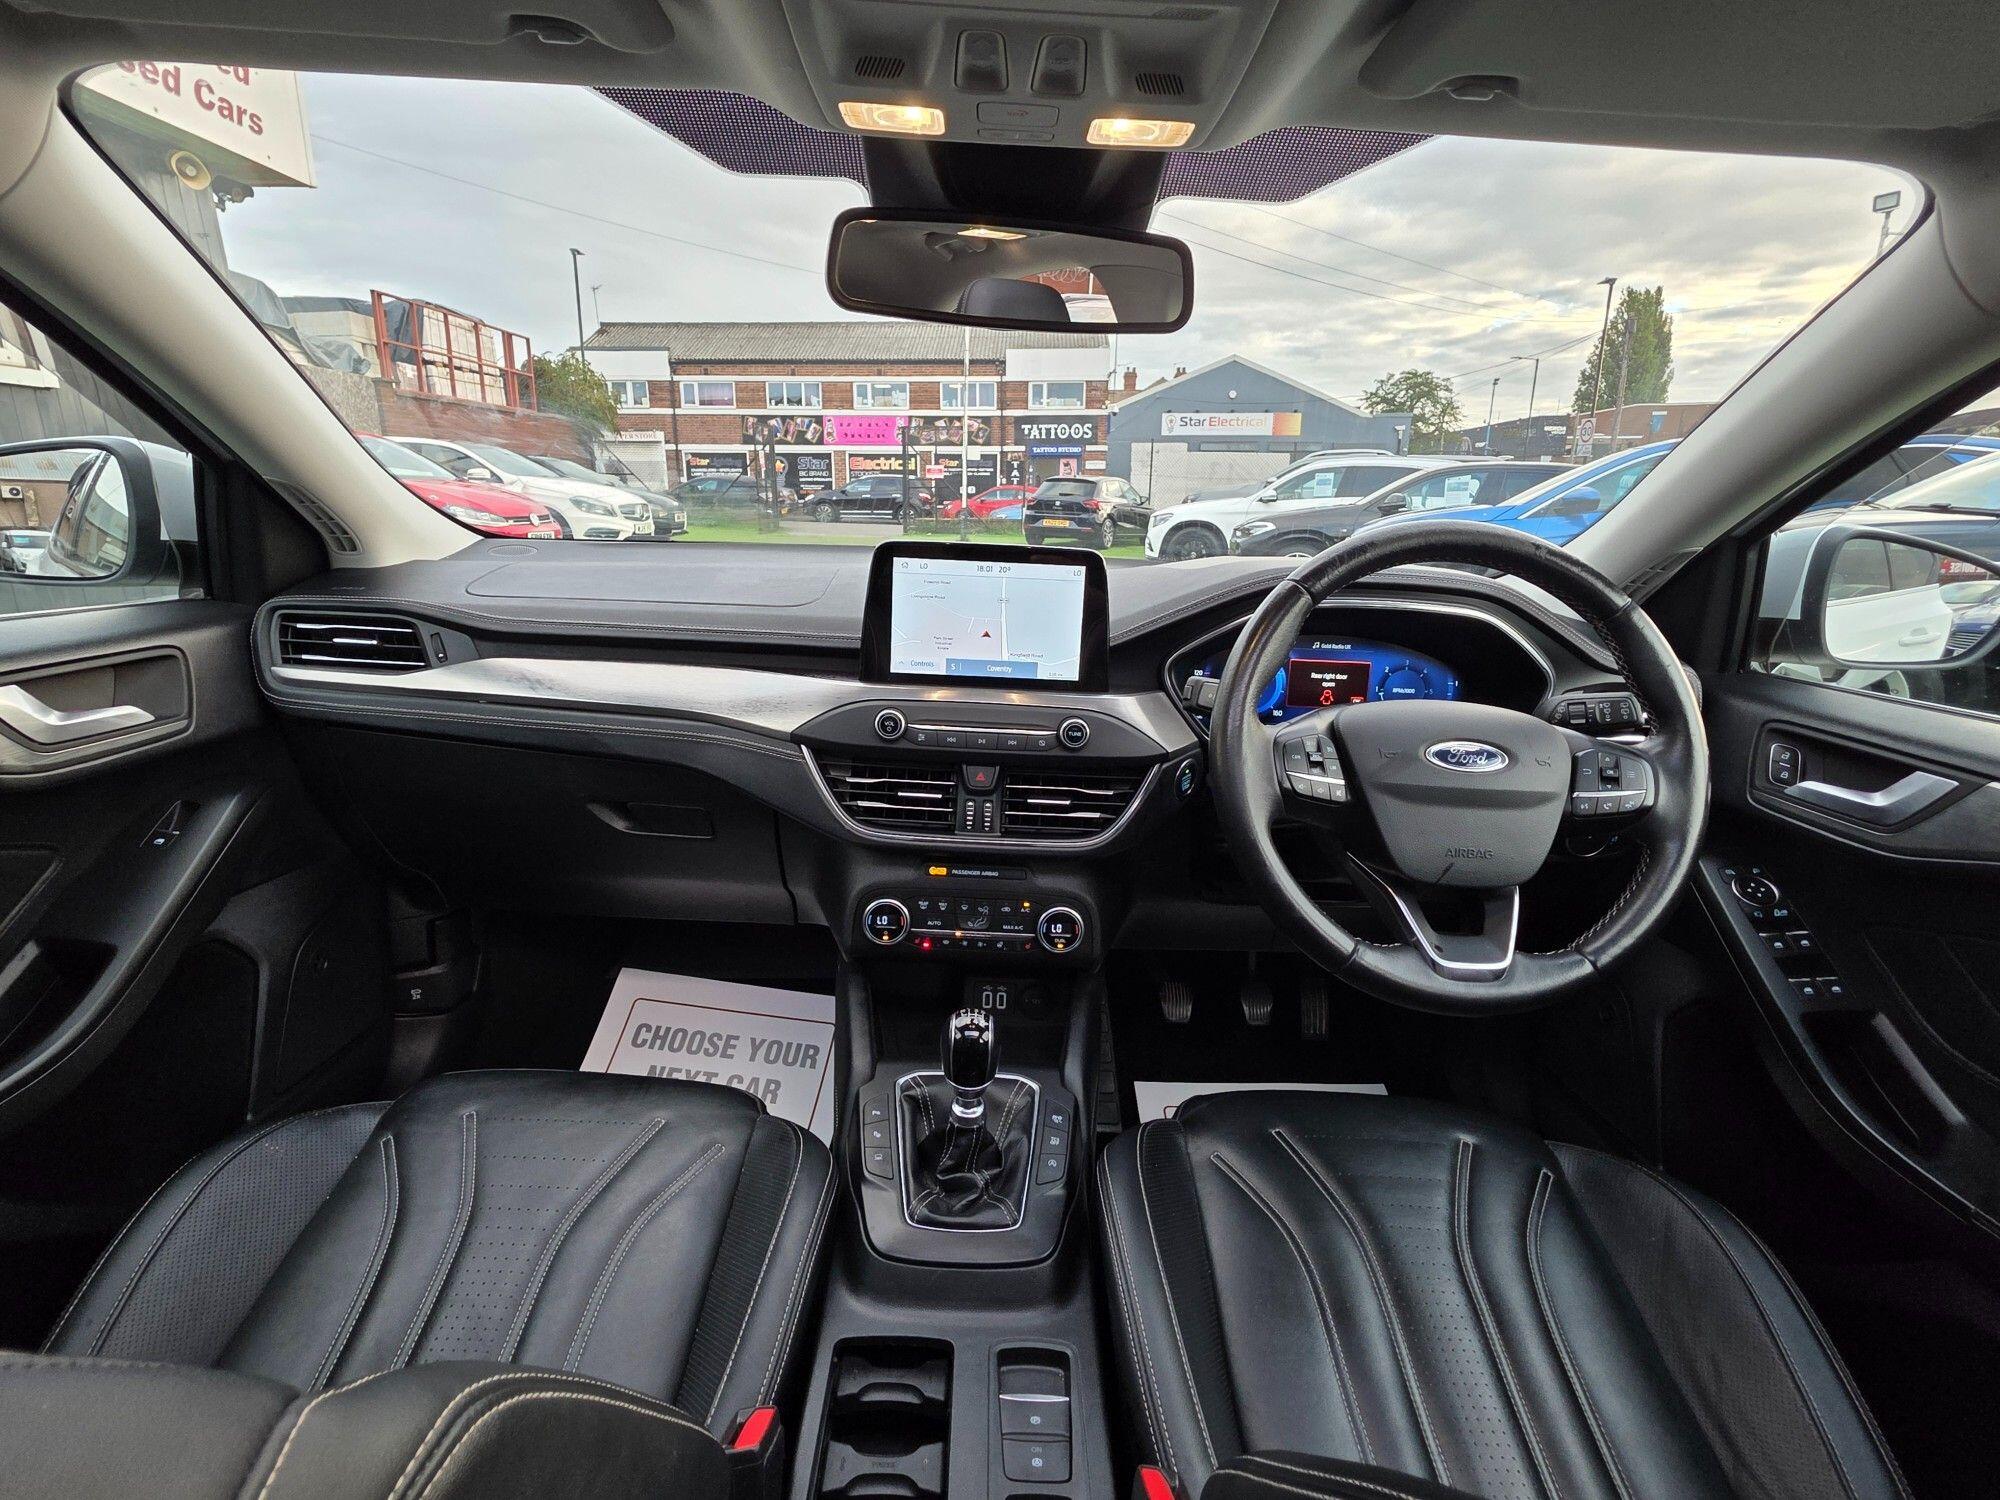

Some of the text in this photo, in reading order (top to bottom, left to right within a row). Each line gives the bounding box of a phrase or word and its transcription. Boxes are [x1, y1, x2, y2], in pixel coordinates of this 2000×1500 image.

[193, 78, 264, 136] Cars
[1179, 415, 1267, 427] Star Electrical
[1021, 423, 1093, 439] TATTOOS
[689, 456, 710, 466] Star
[797, 456, 830, 470] Star
[910, 660, 935, 668] Controls
[986, 664, 1013, 674] Coventry
[1323, 672, 1336, 680] right
[1447, 746, 1489, 765] Ford
[1444, 847, 1494, 860] AIRBAG
[630, 1021, 821, 1070] CHOOSE YOUR
[726, 1073, 783, 1105] CAR
[1031, 1446, 1043, 1454] ON
